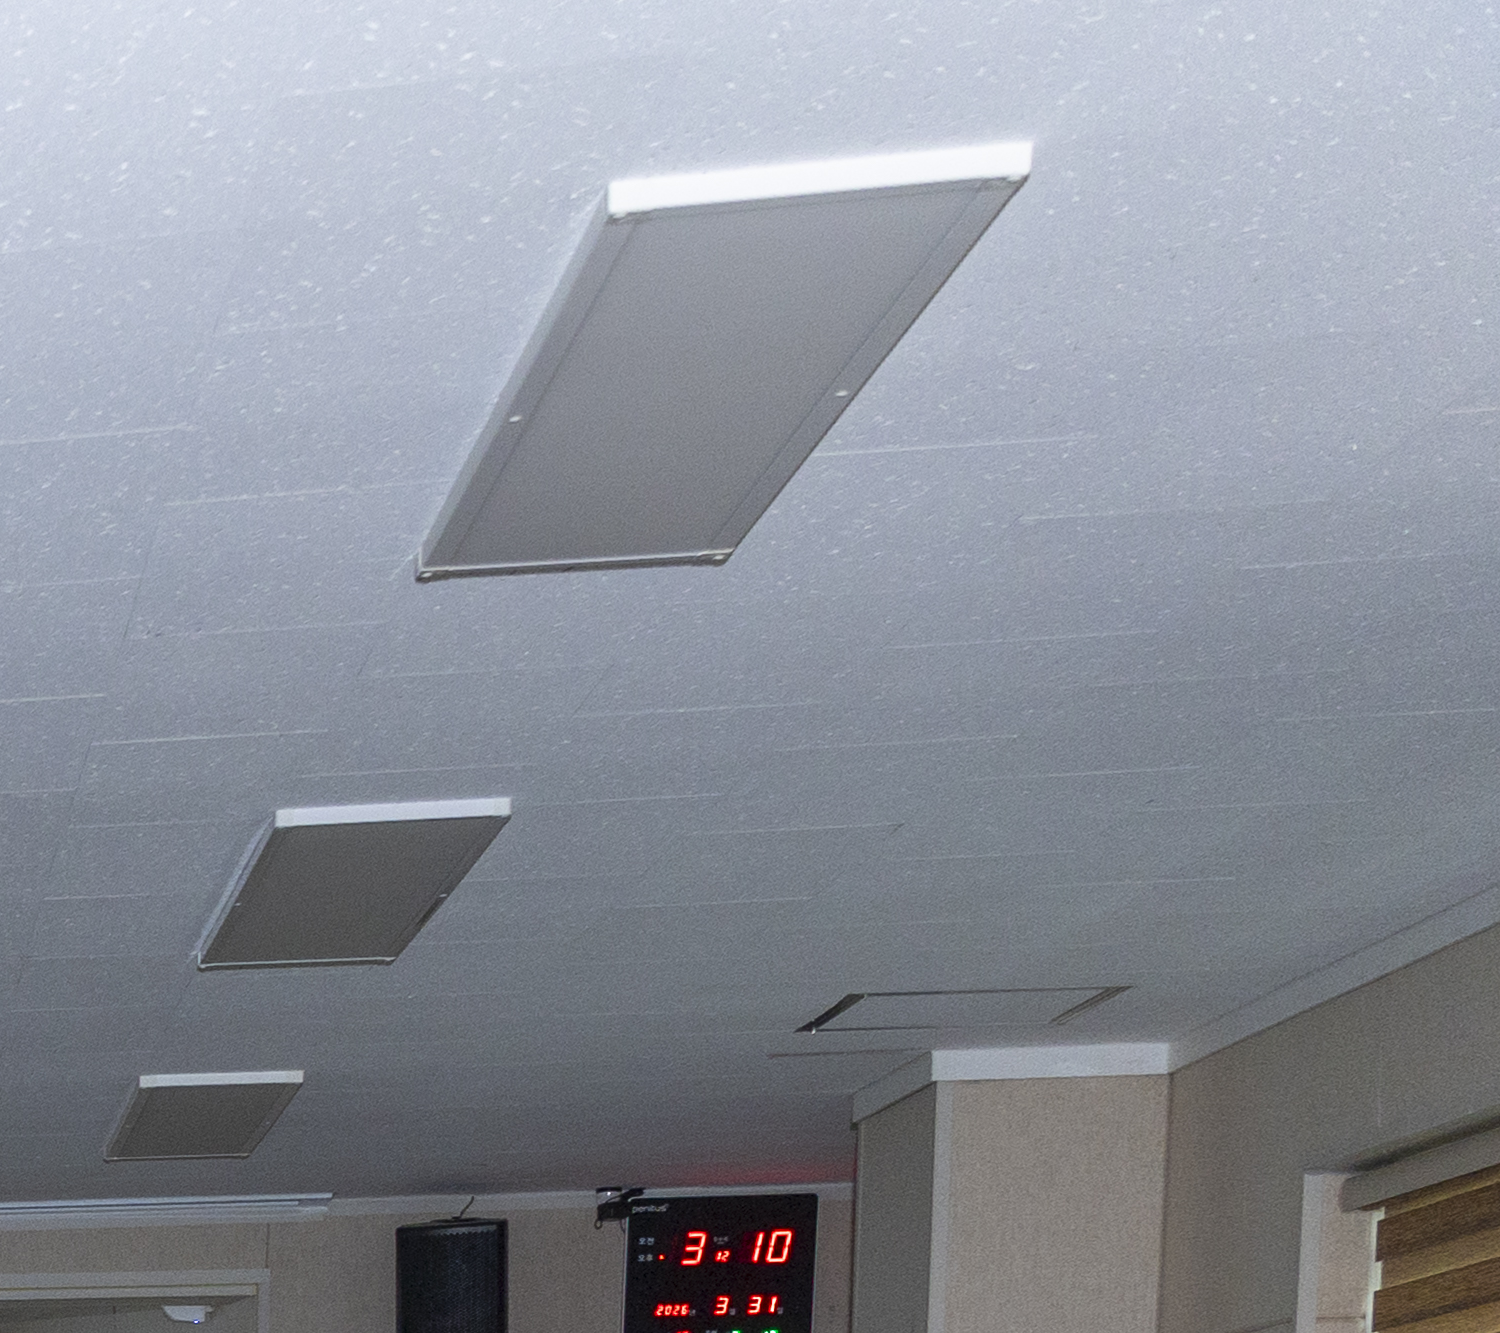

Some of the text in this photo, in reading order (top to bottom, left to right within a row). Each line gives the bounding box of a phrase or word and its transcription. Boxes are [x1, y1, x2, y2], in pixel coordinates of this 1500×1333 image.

[681, 1231, 707, 1266] 3
[714, 1250, 731, 1263] 12
[751, 1230, 793, 1263] 10
